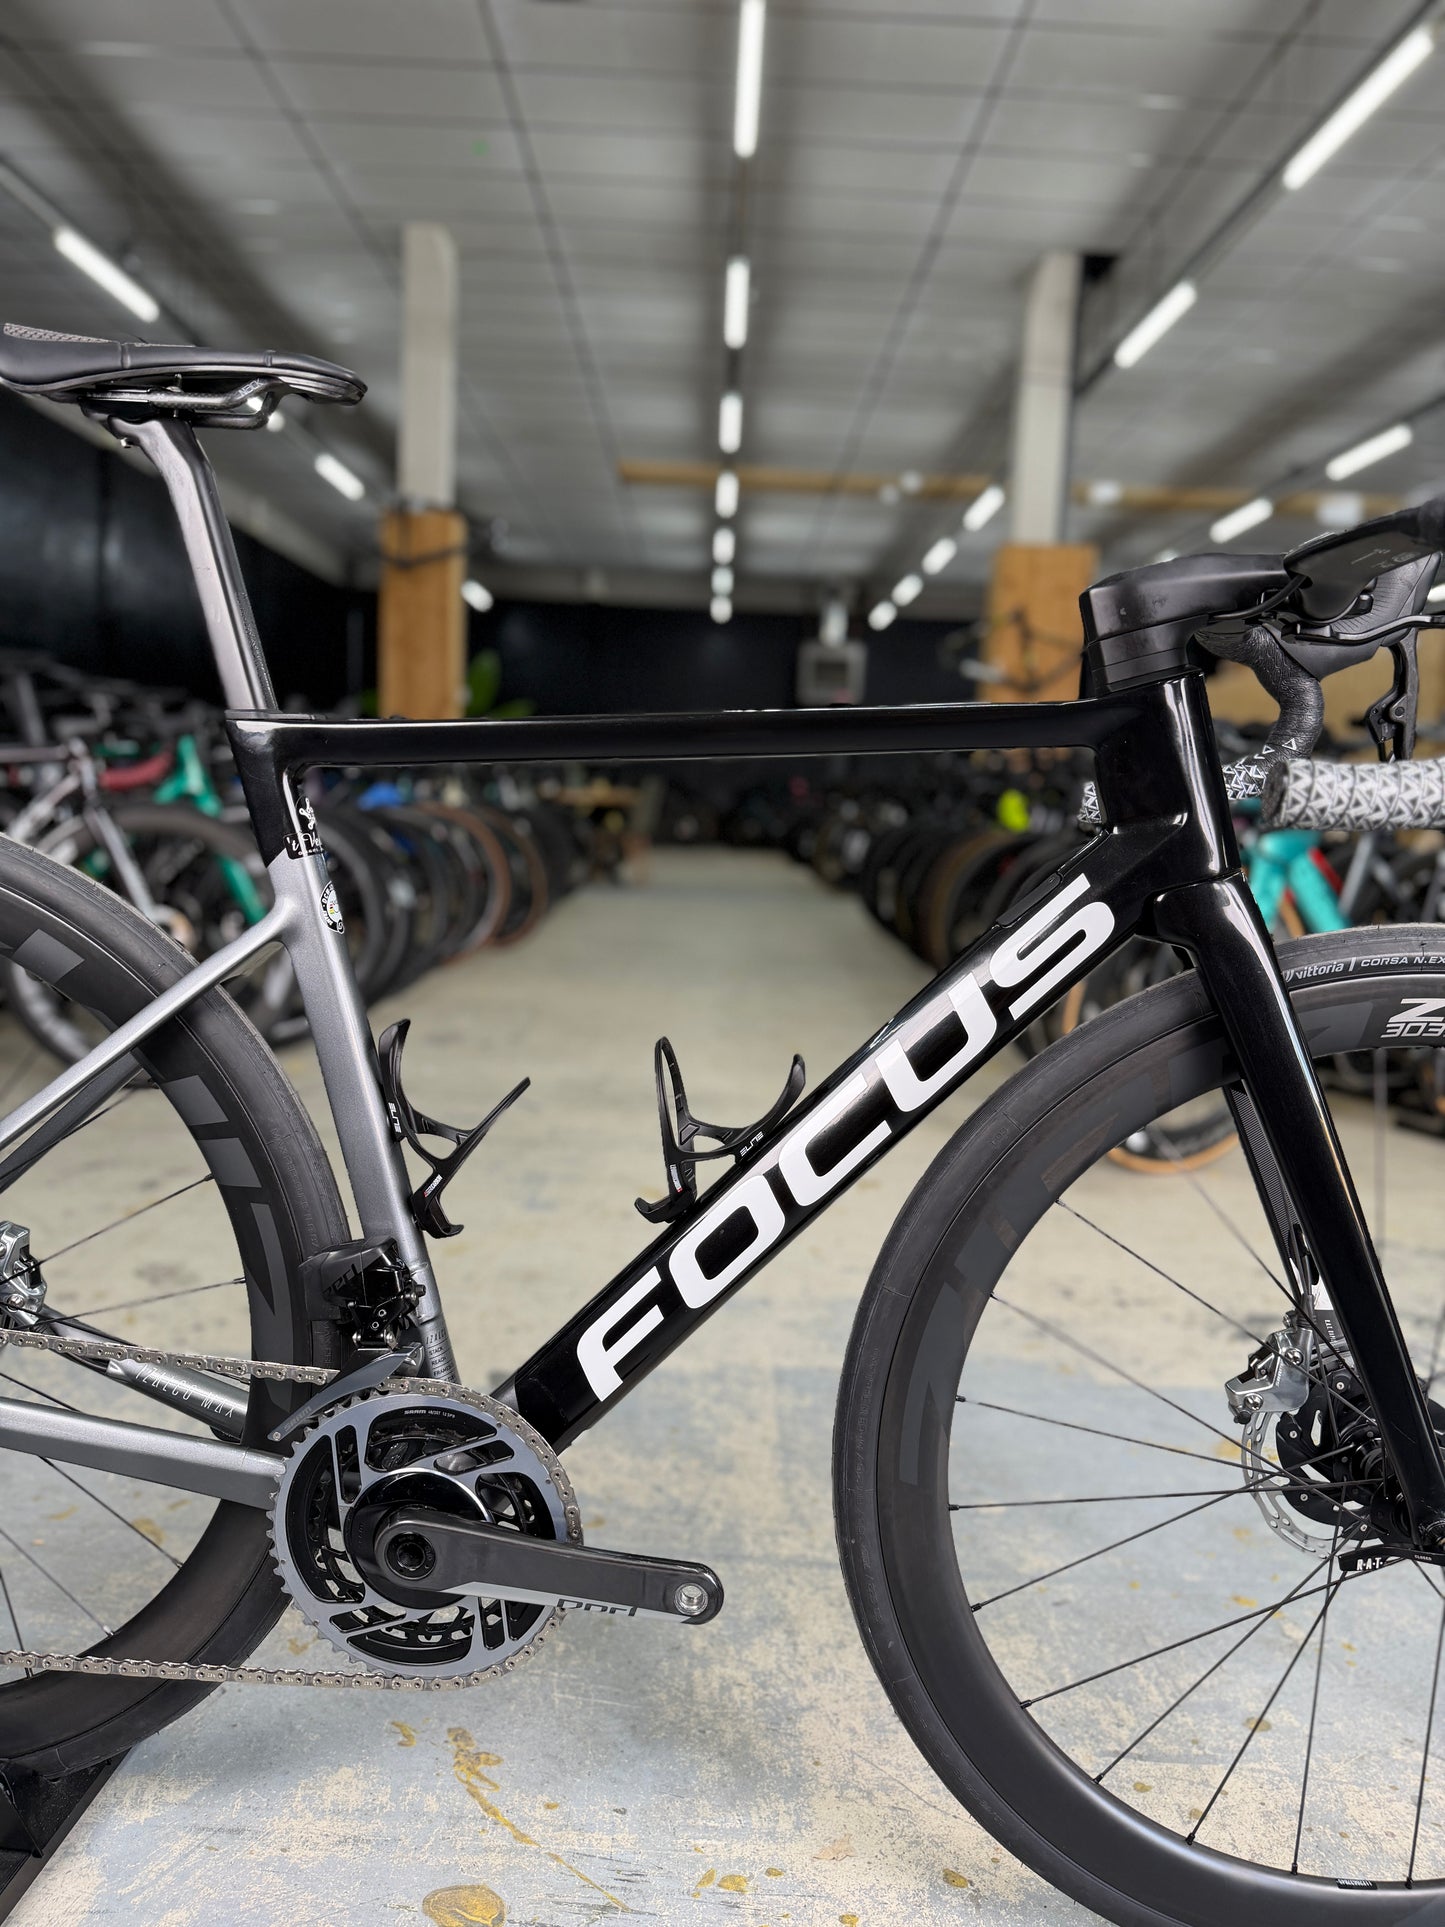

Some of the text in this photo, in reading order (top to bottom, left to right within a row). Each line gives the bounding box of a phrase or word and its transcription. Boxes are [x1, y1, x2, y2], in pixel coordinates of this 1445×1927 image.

[1295, 961, 1344, 980] vittoria
[1361, 956, 1408, 967] CORSA
[576, 873, 1115, 1401] FOCUS
[740, 1131, 764, 1157] ELITE
[135, 1363, 238, 1418] IZALCO MAX
